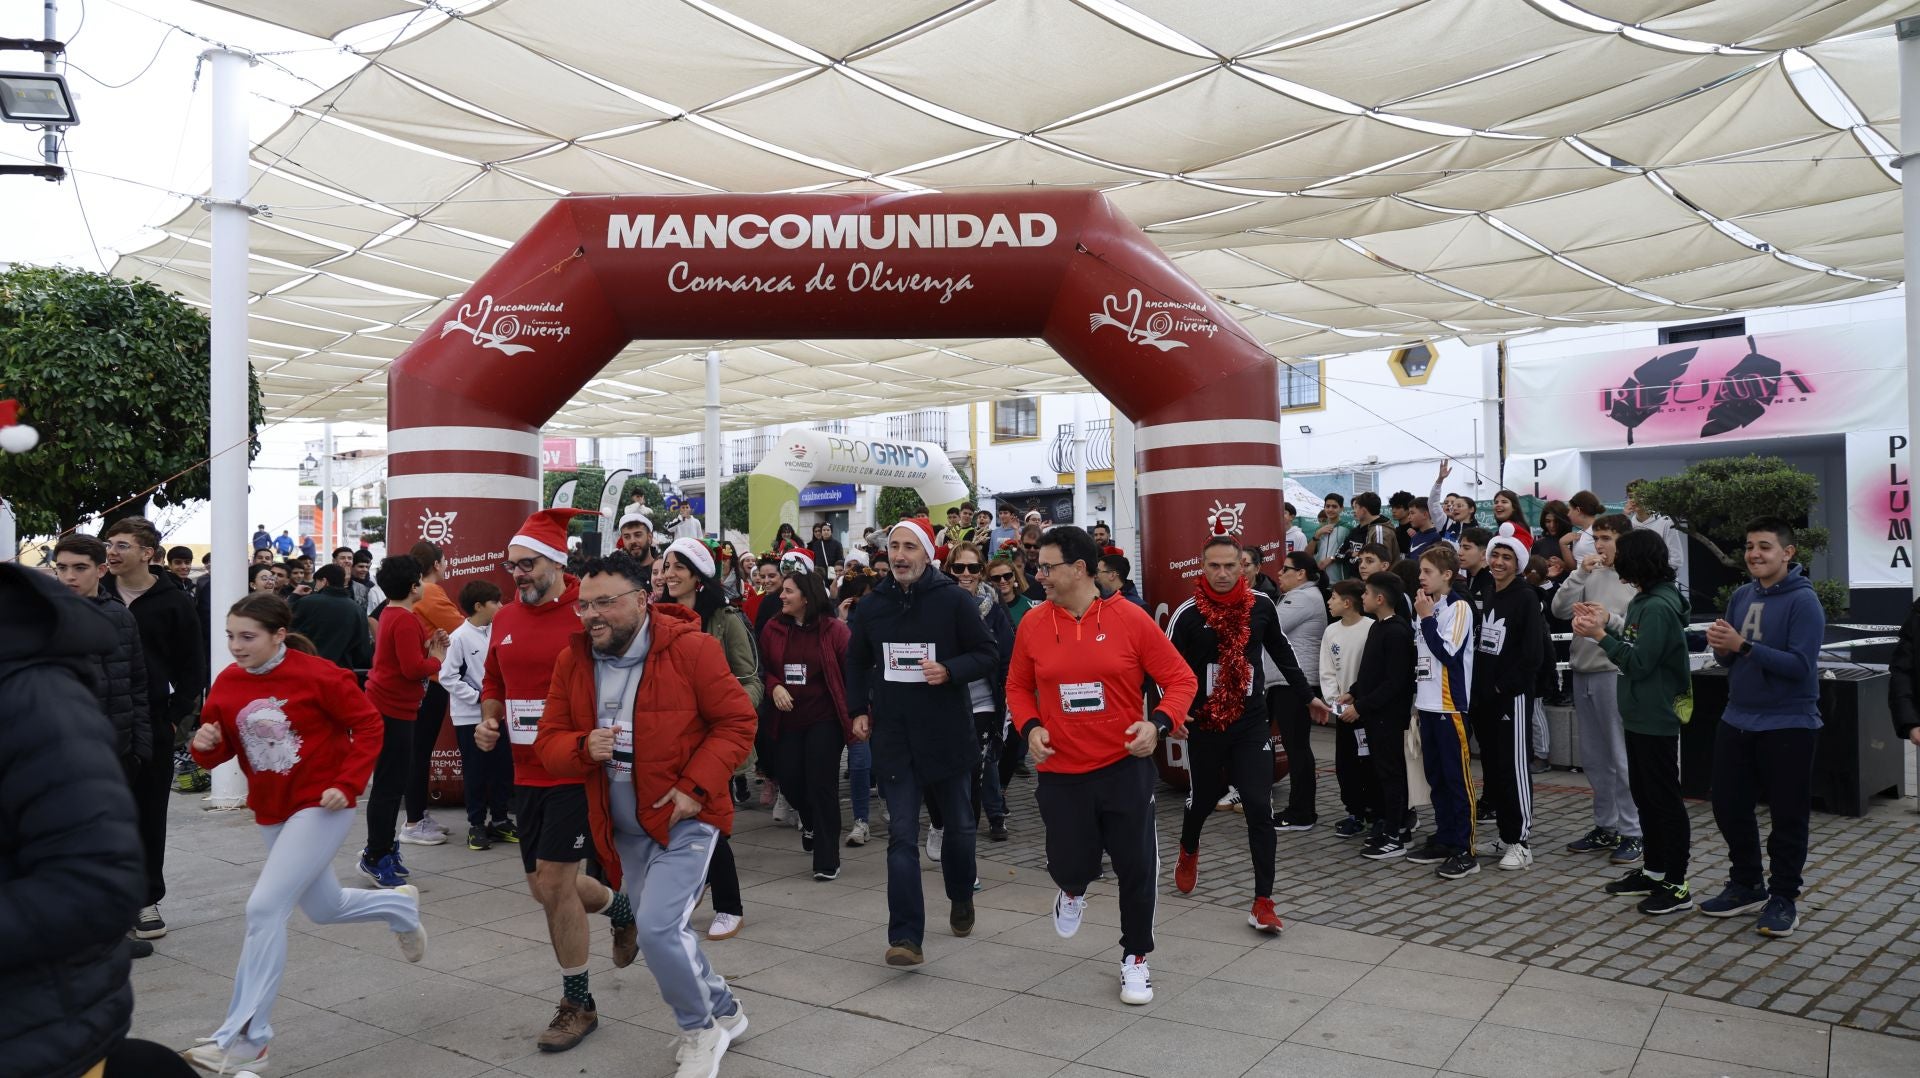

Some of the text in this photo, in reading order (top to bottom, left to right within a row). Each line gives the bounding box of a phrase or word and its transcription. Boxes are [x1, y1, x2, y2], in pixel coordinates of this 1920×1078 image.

[607, 213, 1058, 250] MANCOMUNIDAD
[667, 261, 974, 304] Comarca de Olivenza
[827, 437, 929, 468] PROGRIFO
[1888, 435, 1912, 569] PLUMA
[450, 553, 485, 566] Igualdad
[487, 550, 504, 560] Real
[452, 563, 494, 576] Hombres!!
[1741, 602, 1765, 641] A
